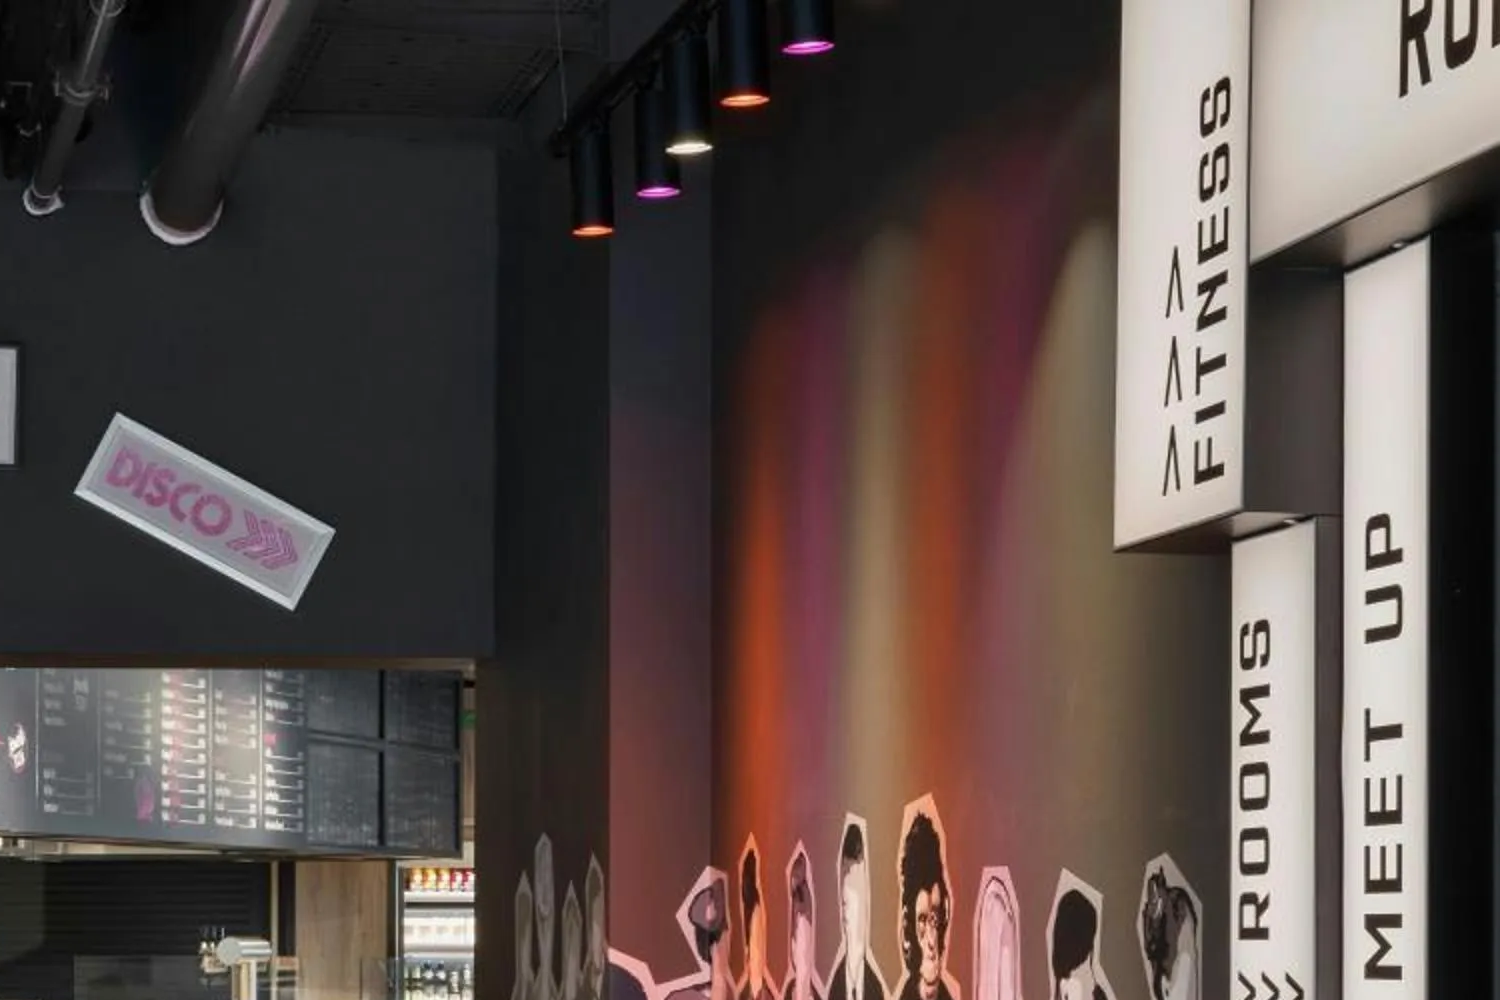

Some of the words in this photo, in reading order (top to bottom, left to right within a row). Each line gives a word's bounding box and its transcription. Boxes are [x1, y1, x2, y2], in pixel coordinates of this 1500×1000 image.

[1194, 76, 1232, 486] FITNESS
[105, 447, 232, 537] DISCO
[1364, 512, 1404, 645] UP
[1238, 617, 1271, 942] ROOMS
[1364, 707, 1404, 981] MEET
